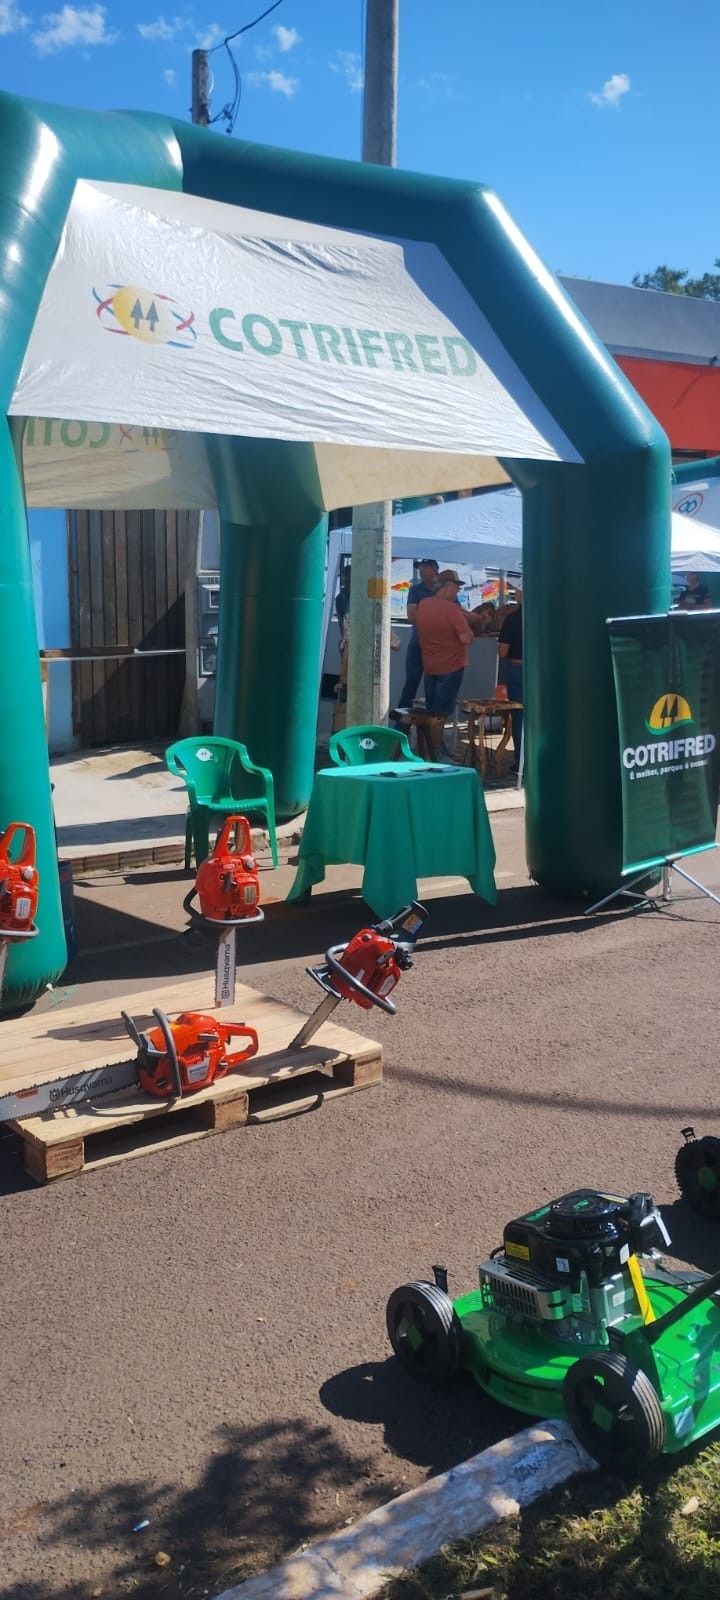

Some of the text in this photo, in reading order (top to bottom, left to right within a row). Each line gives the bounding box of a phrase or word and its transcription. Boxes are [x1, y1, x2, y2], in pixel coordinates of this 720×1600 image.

[208, 307, 477, 377] COTRIFRED
[623, 734, 715, 769] COTRIFRED
[222, 943, 231, 989] Husqvarna
[61, 1077, 113, 1098] Husqvarna
